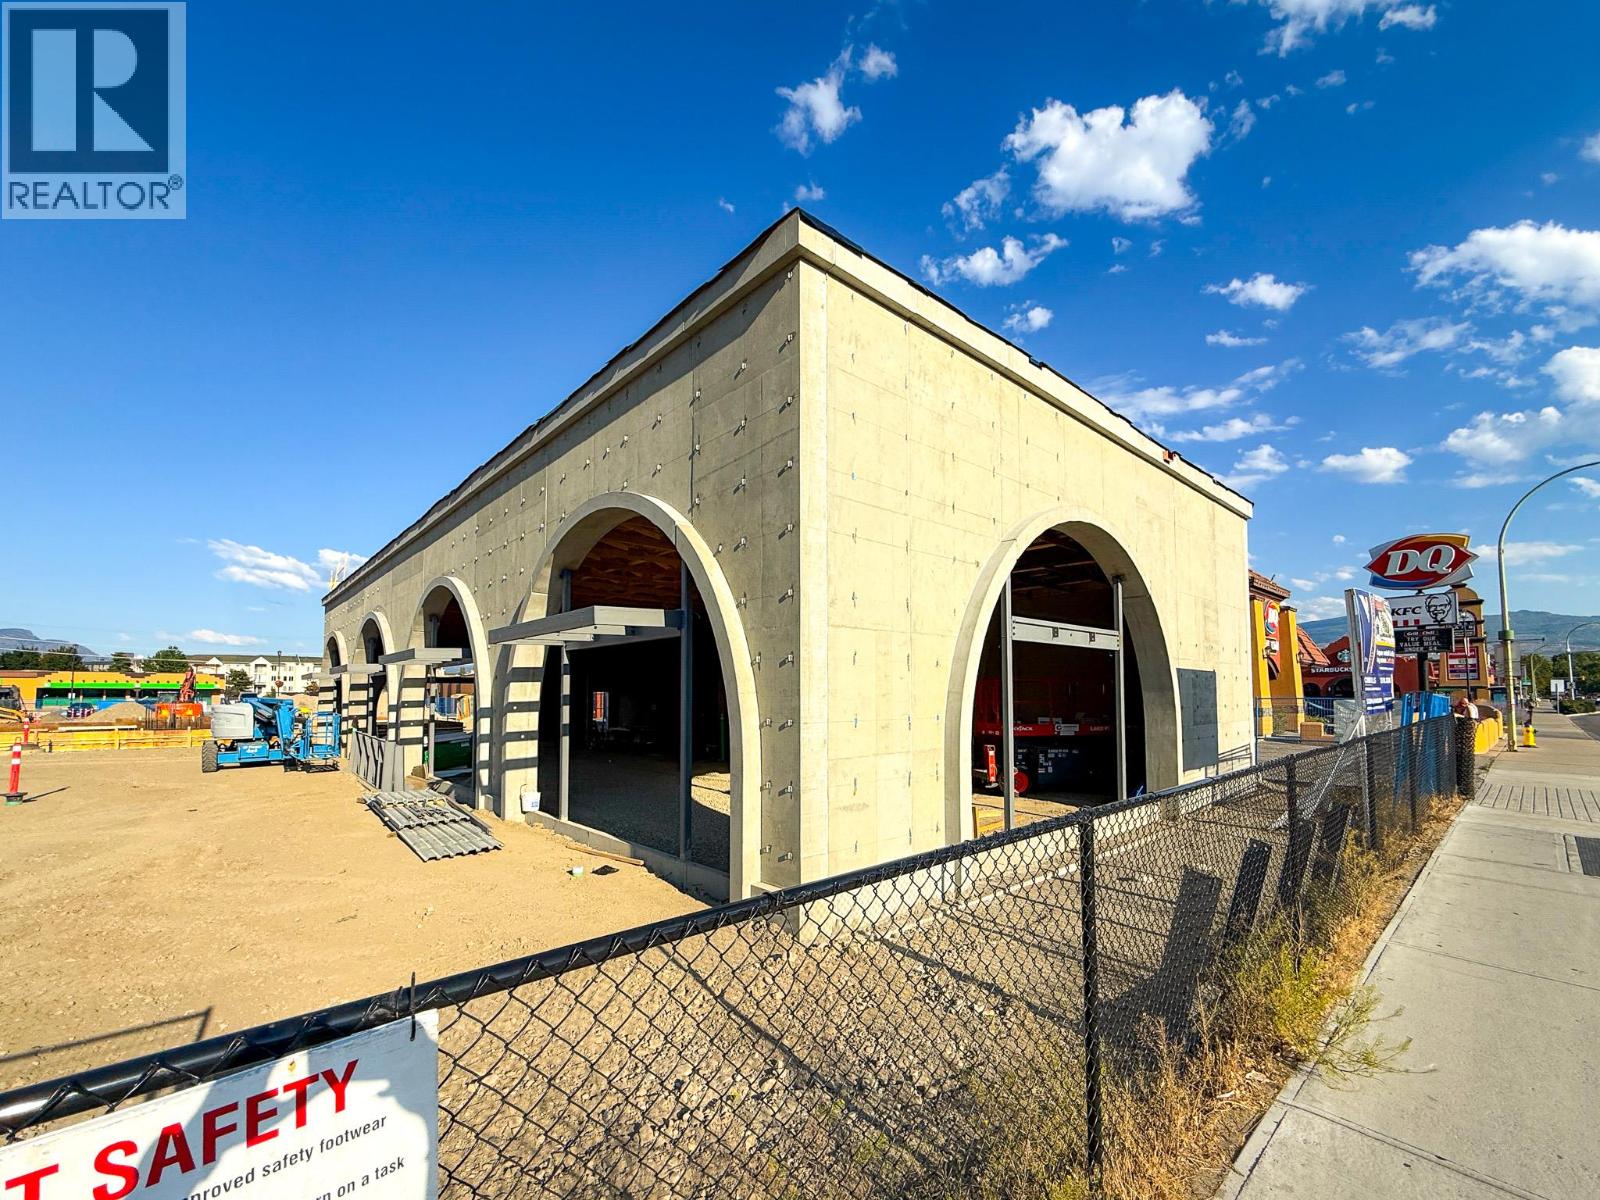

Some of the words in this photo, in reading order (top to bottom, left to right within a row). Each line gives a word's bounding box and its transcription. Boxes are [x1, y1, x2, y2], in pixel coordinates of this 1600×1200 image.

[1384, 544, 1456, 576] DQ
[1391, 606, 1422, 616] KFC
[92, 1058, 360, 1200] SAFETY
[262, 1145, 314, 1177] safety
[319, 1114, 388, 1155] footwear
[337, 1180, 355, 1197] on
[361, 1173, 370, 1186] a
[375, 1156, 405, 1180] task
